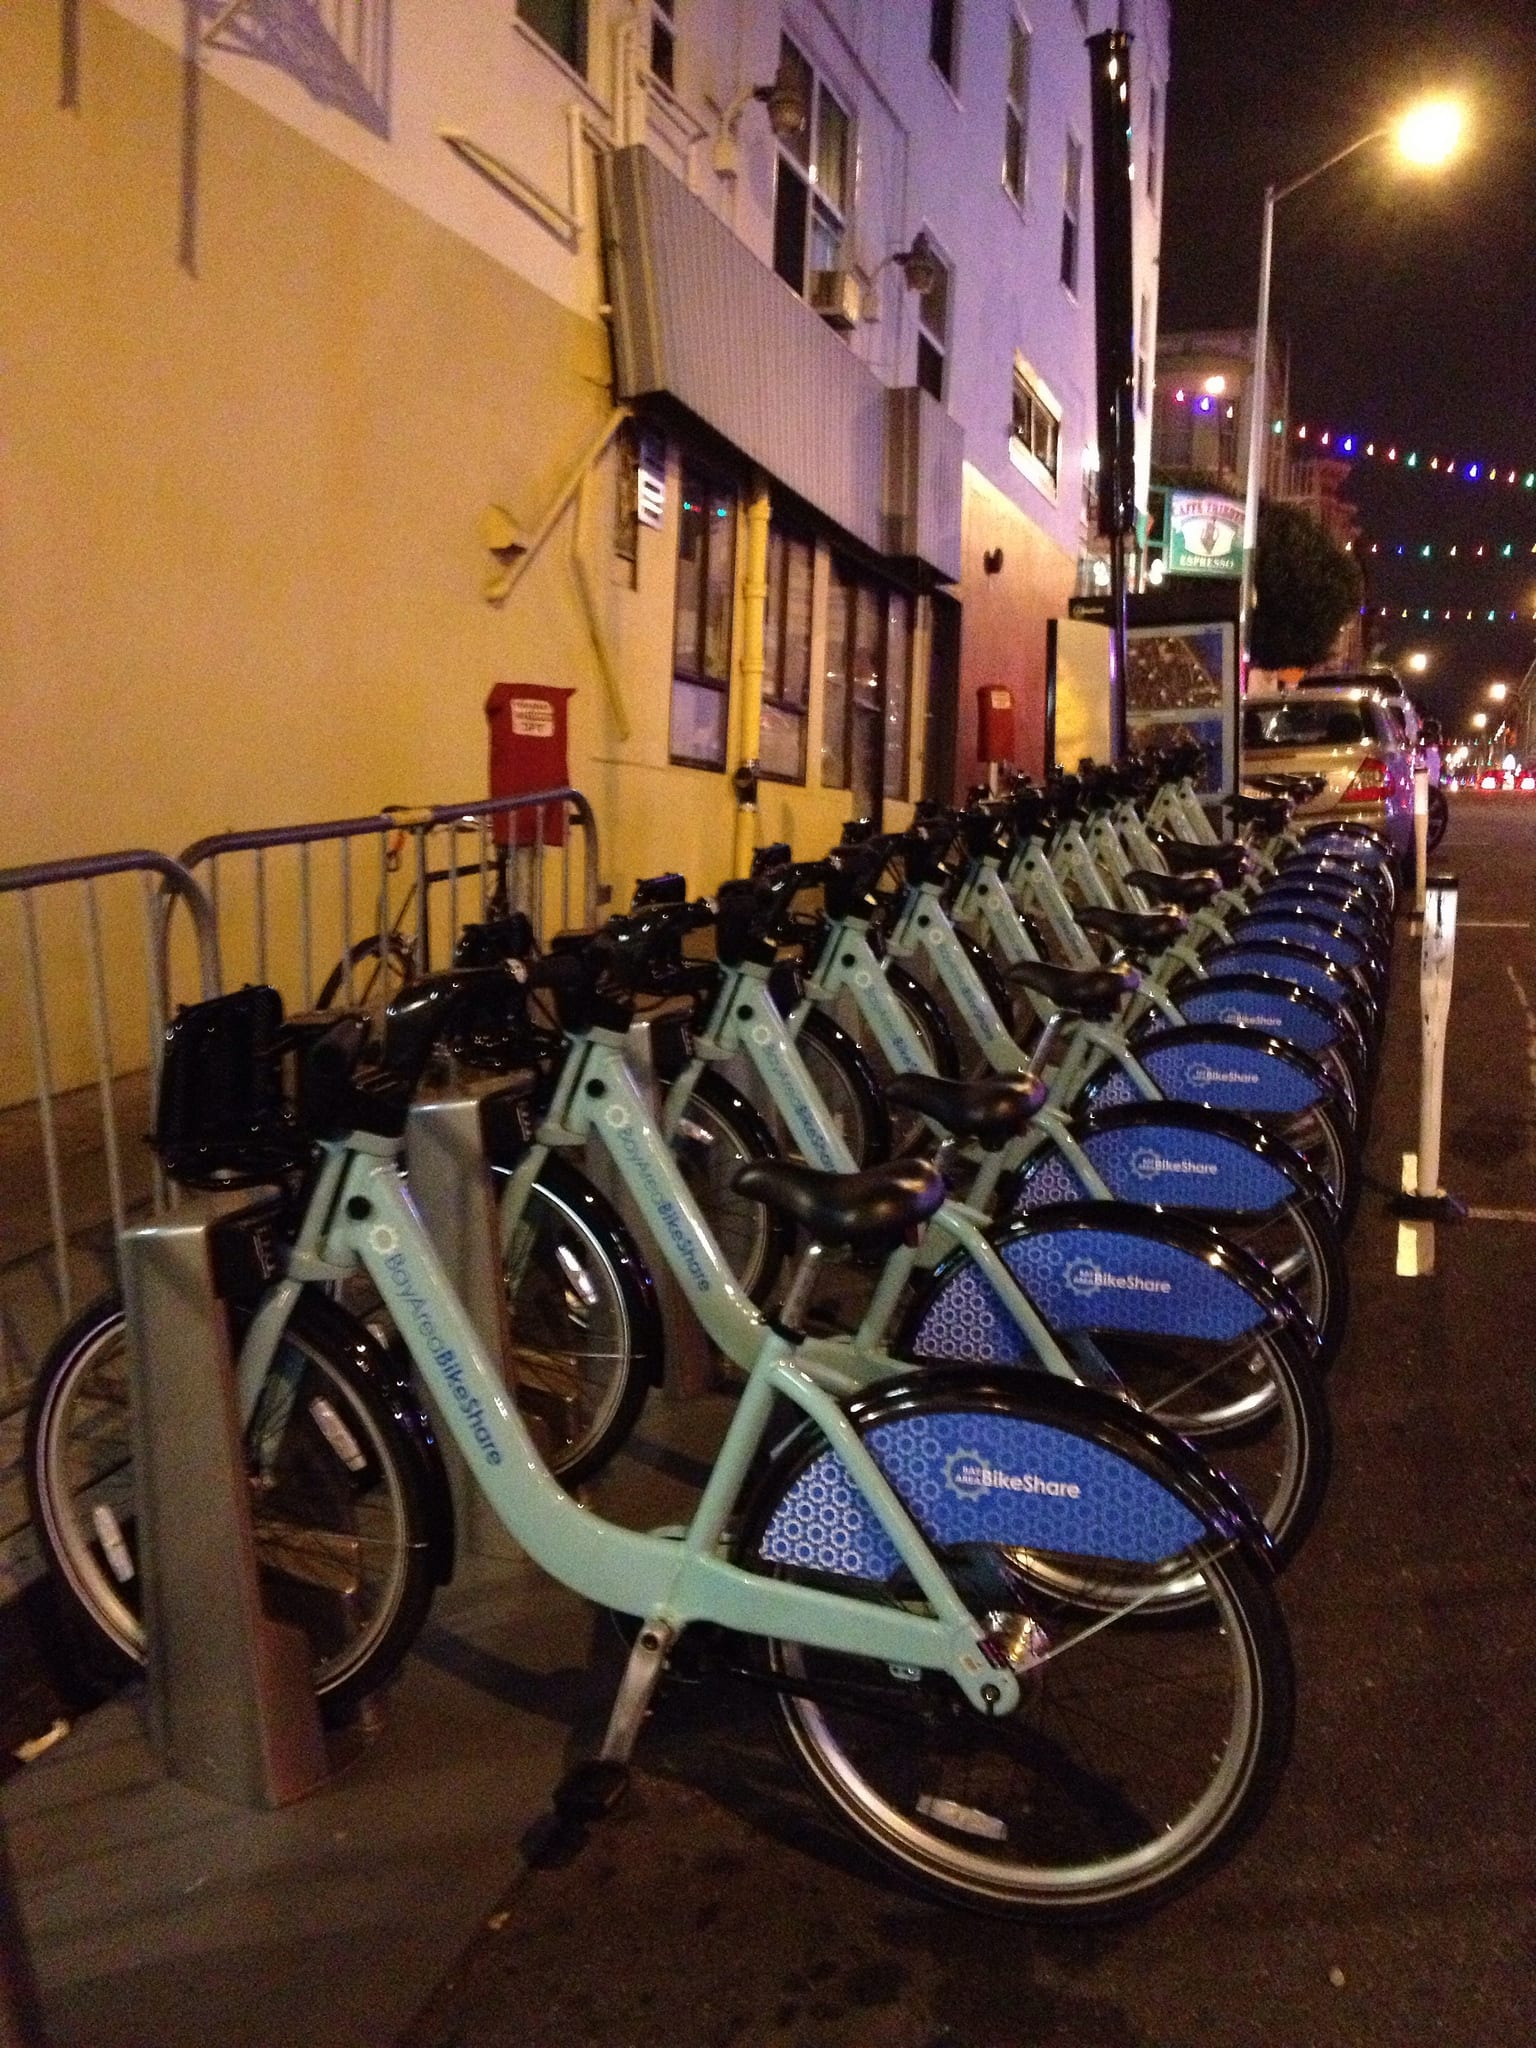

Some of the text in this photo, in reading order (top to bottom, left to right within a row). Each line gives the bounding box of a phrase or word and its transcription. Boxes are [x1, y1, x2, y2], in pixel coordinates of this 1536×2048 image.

[1179, 554, 1235, 569] ESPRESSO
[1155, 1158, 1218, 1175] BikeShare
[1095, 1271, 1172, 1294] BikeShare
[384, 1253, 502, 1467] BayAreaBikeShare
[981, 1468, 1081, 1500] BikeShare
